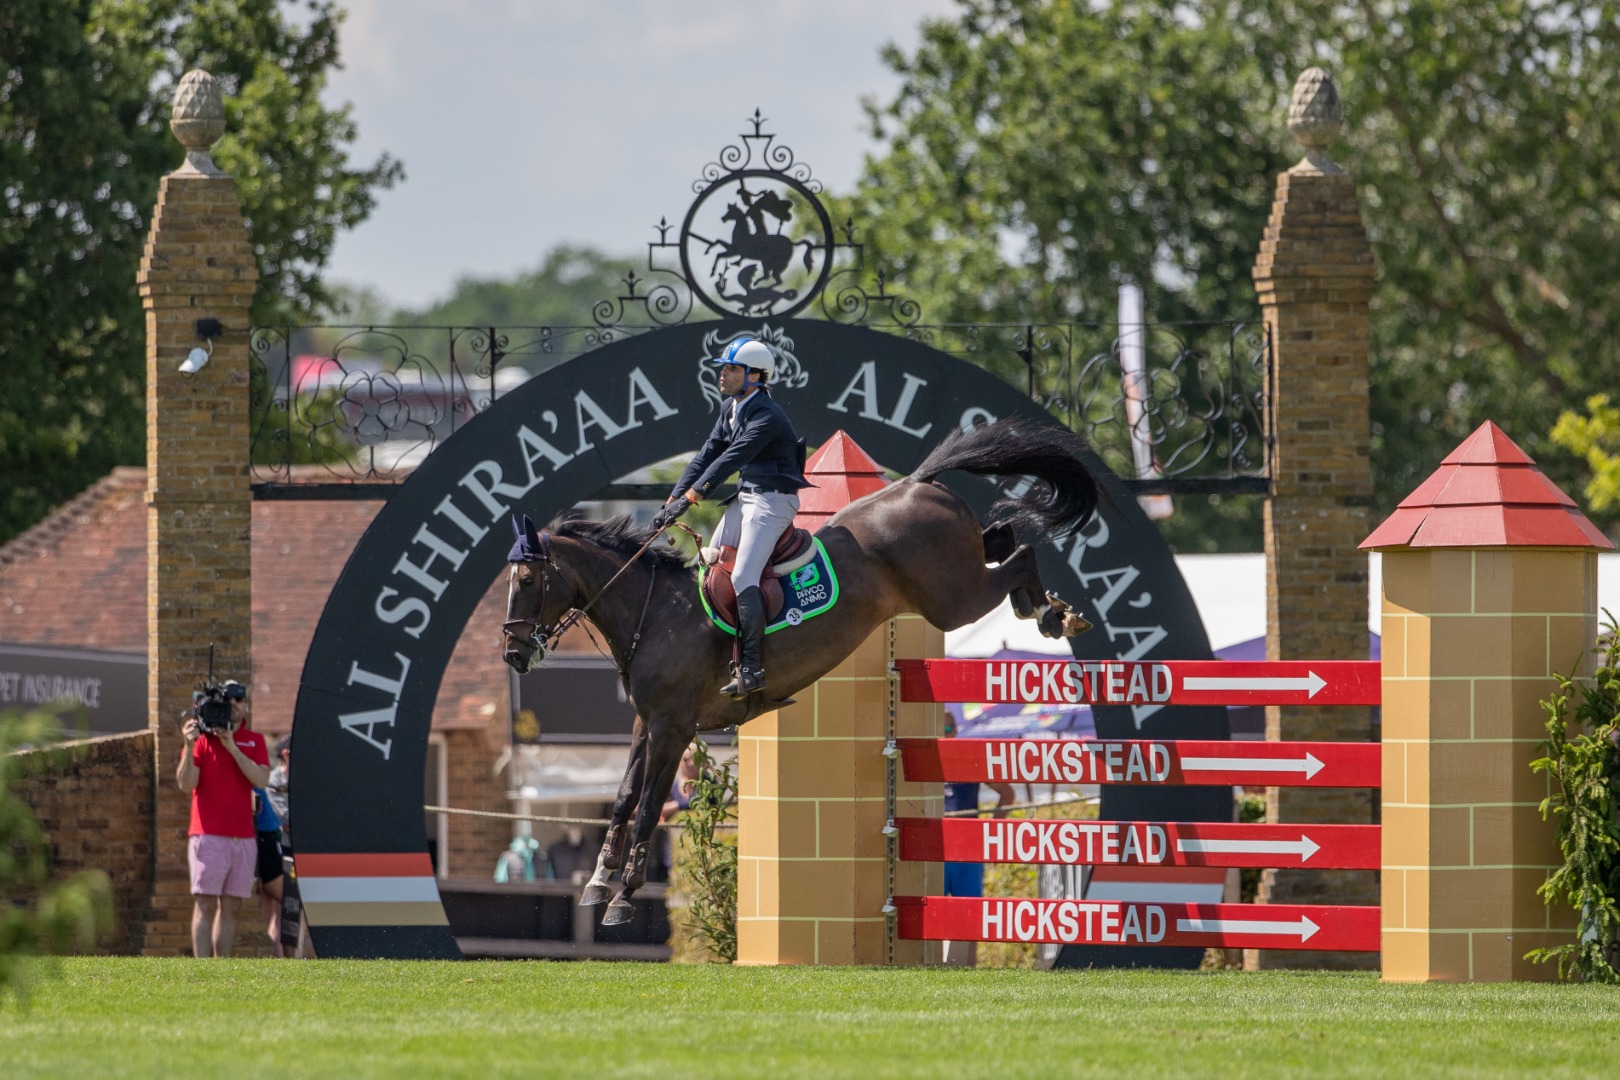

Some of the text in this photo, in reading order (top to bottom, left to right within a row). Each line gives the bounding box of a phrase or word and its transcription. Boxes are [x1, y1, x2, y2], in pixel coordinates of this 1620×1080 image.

[338, 366, 679, 760] AL SHIRA'AA
[827, 360, 1169, 730] AL RA'A
[985, 661, 1173, 704] HICKSTEAD
[985, 741, 1171, 783] HICKSTEAD
[982, 821, 1167, 864] HICKSTEAD
[981, 900, 1167, 943] HICKSTEAD
